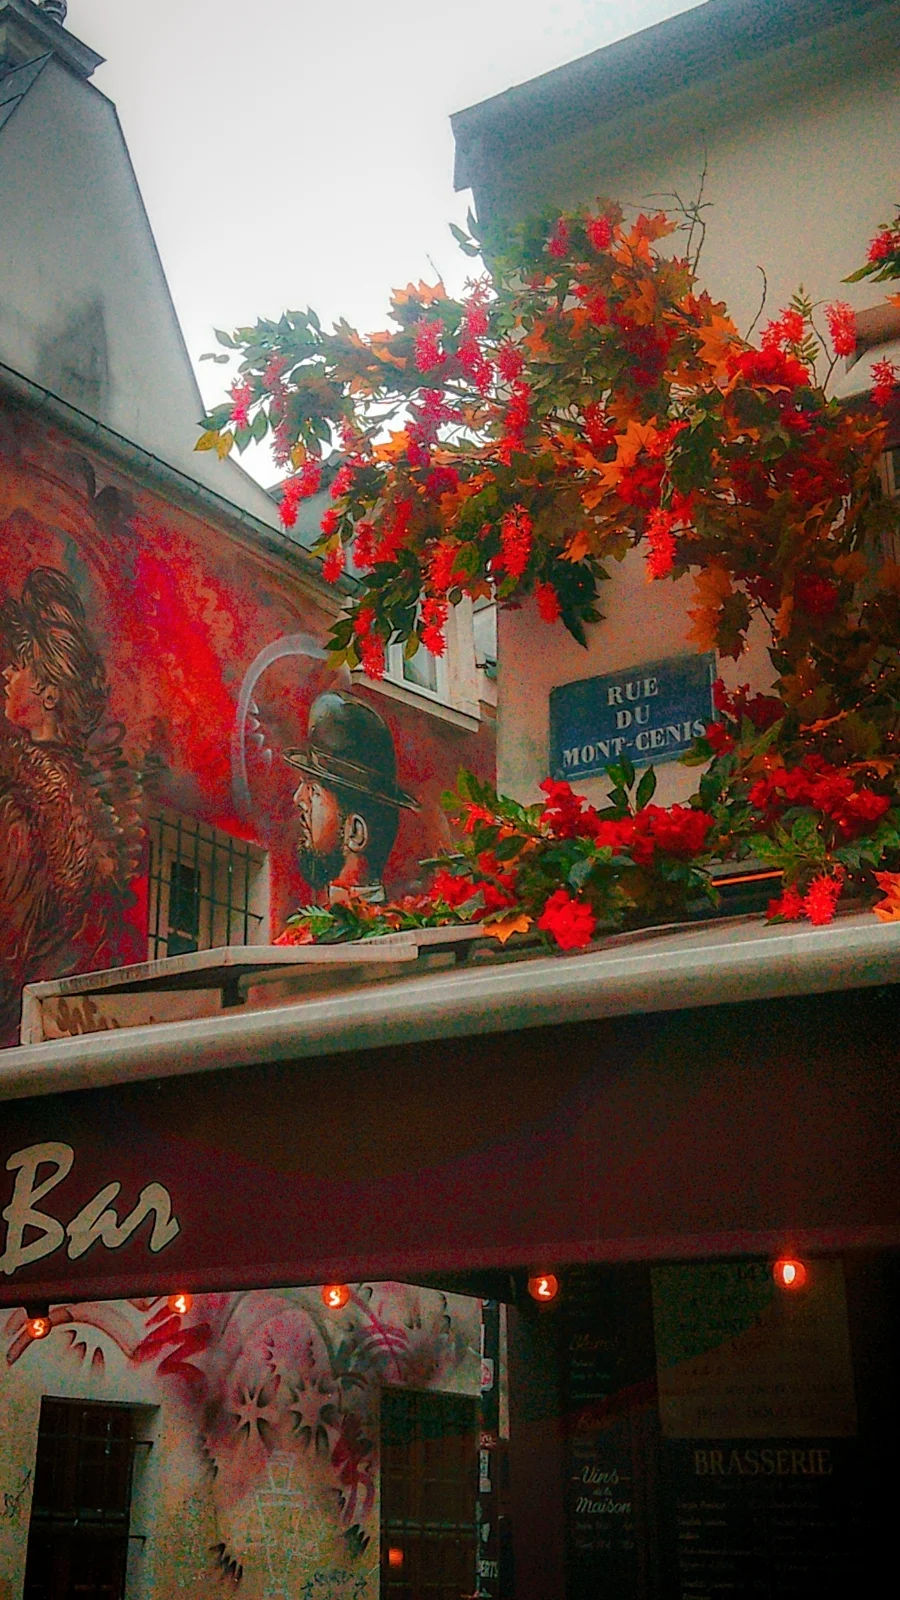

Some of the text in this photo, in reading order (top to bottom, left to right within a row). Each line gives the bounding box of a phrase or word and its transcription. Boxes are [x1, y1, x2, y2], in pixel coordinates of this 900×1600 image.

[607, 677, 659, 706] RUE
[616, 704, 650, 730] DU
[563, 718, 707, 768] MONT-CENIS
[0, 1141, 181, 1276] Bar
[693, 1448, 834, 1476] BRASSERIE
[575, 1496, 632, 1514] Maison
